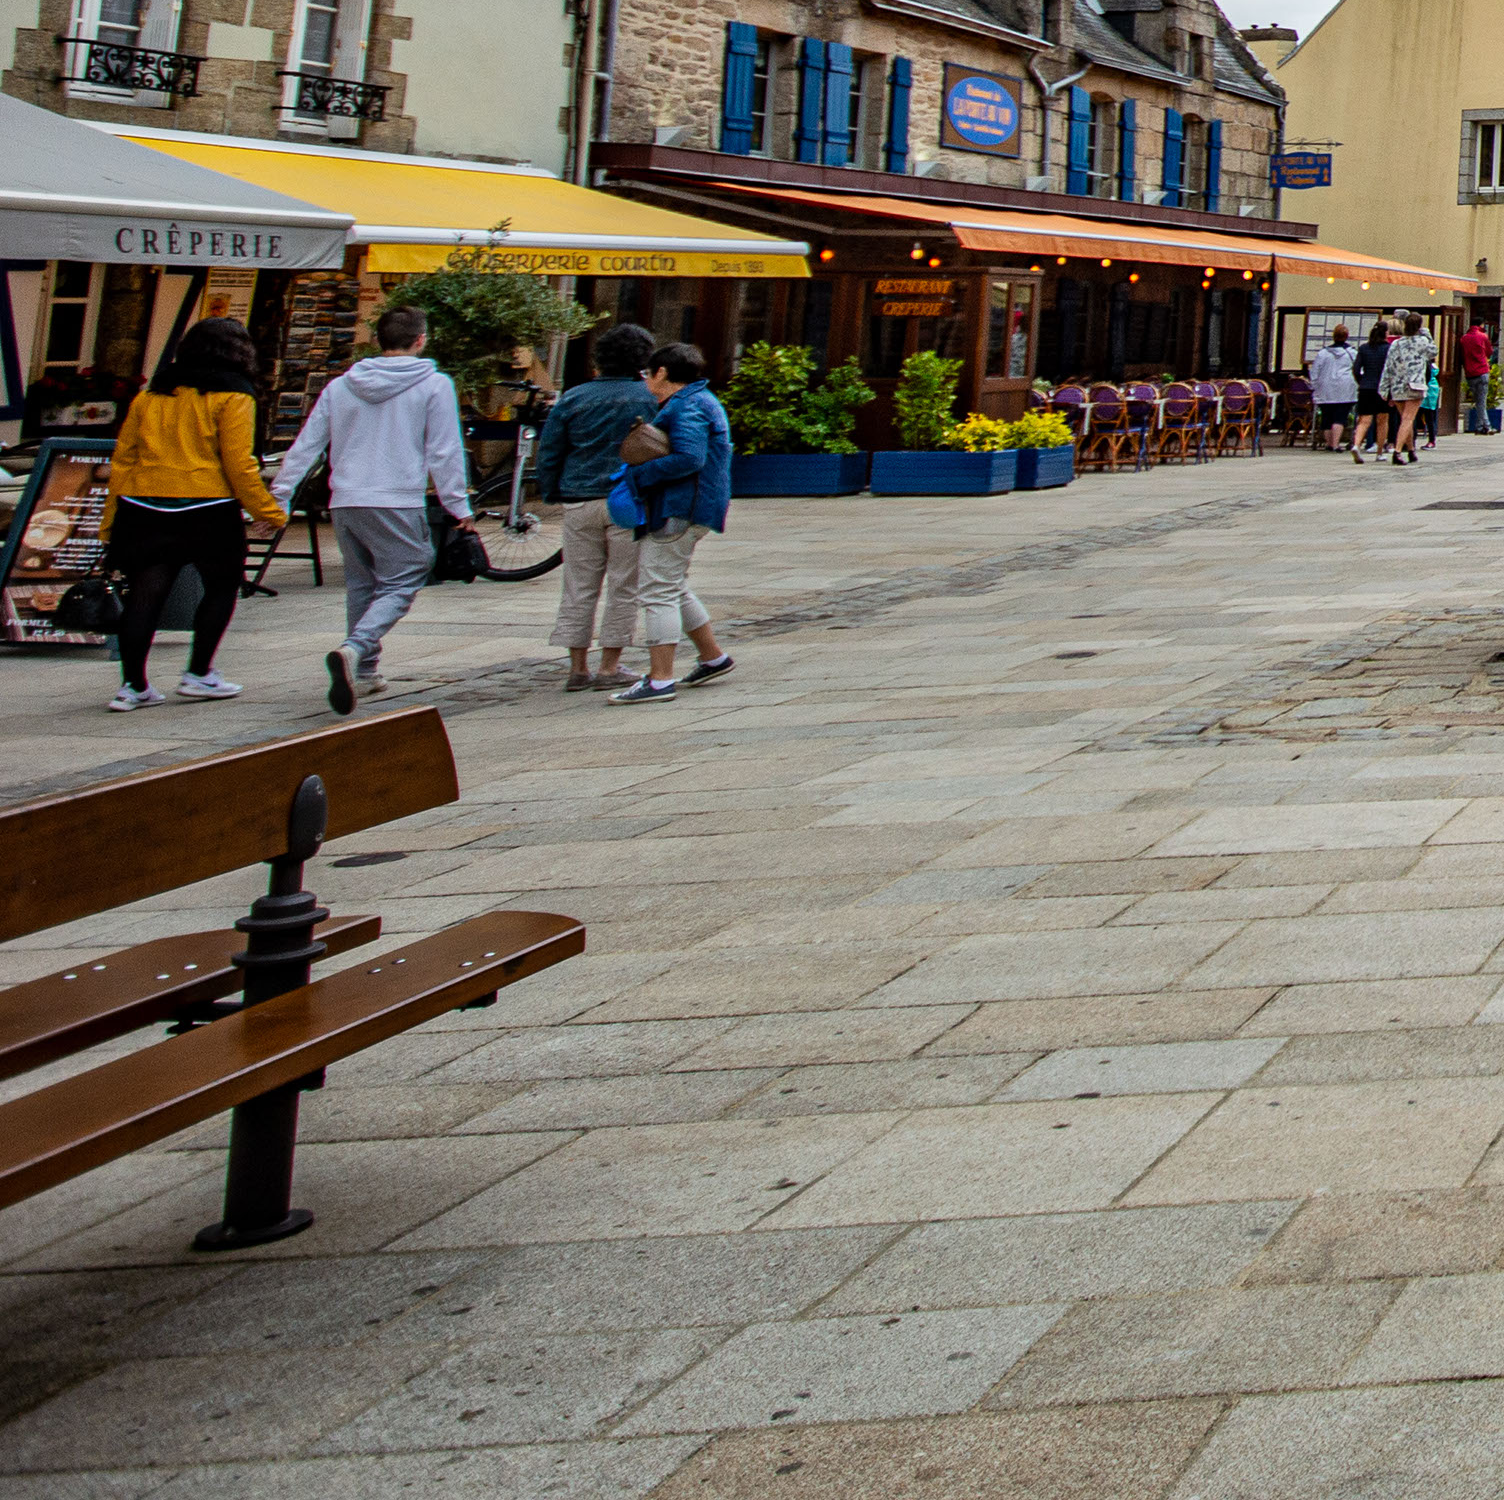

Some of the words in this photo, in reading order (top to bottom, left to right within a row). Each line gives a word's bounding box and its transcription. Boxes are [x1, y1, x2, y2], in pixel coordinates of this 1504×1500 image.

[115, 222, 283, 258] CRÊPERIE
[874, 279, 953, 294] RESTAURANT
[69, 455, 111, 464] FORMUL
[89, 487, 110, 495] PLA
[6, 619, 53, 627] FORMUL
